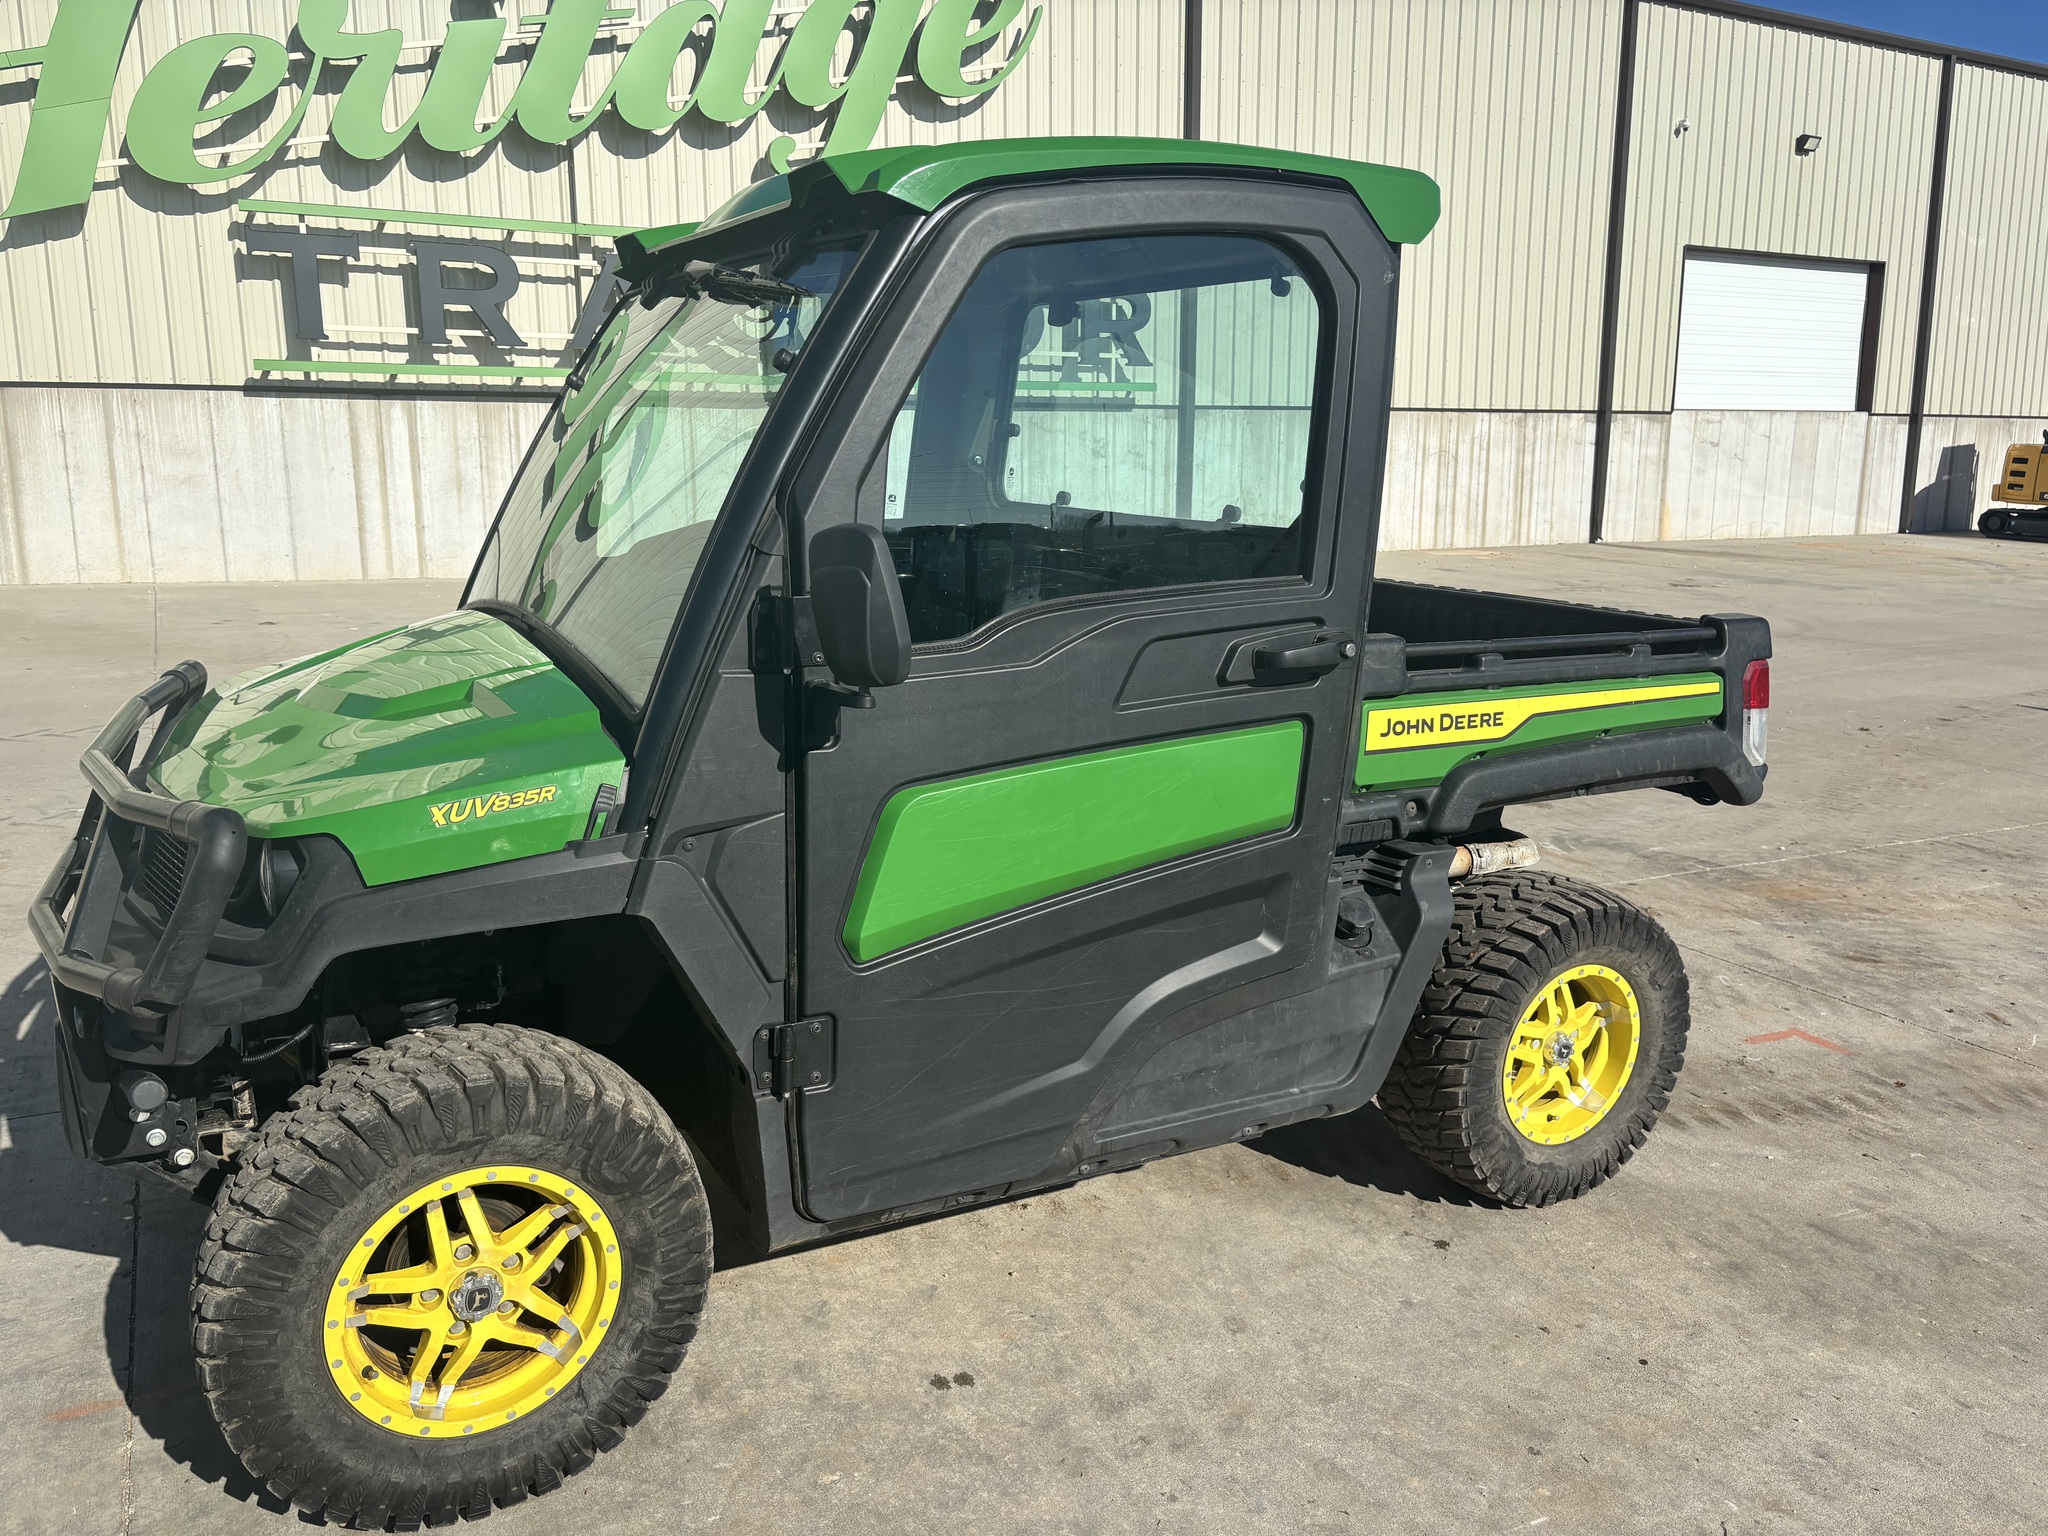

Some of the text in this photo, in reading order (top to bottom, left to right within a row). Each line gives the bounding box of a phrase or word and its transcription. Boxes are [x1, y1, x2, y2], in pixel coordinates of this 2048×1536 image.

[1379, 711, 1504, 738] JOHN DEERE
[429, 784, 557, 827] XUV835R
